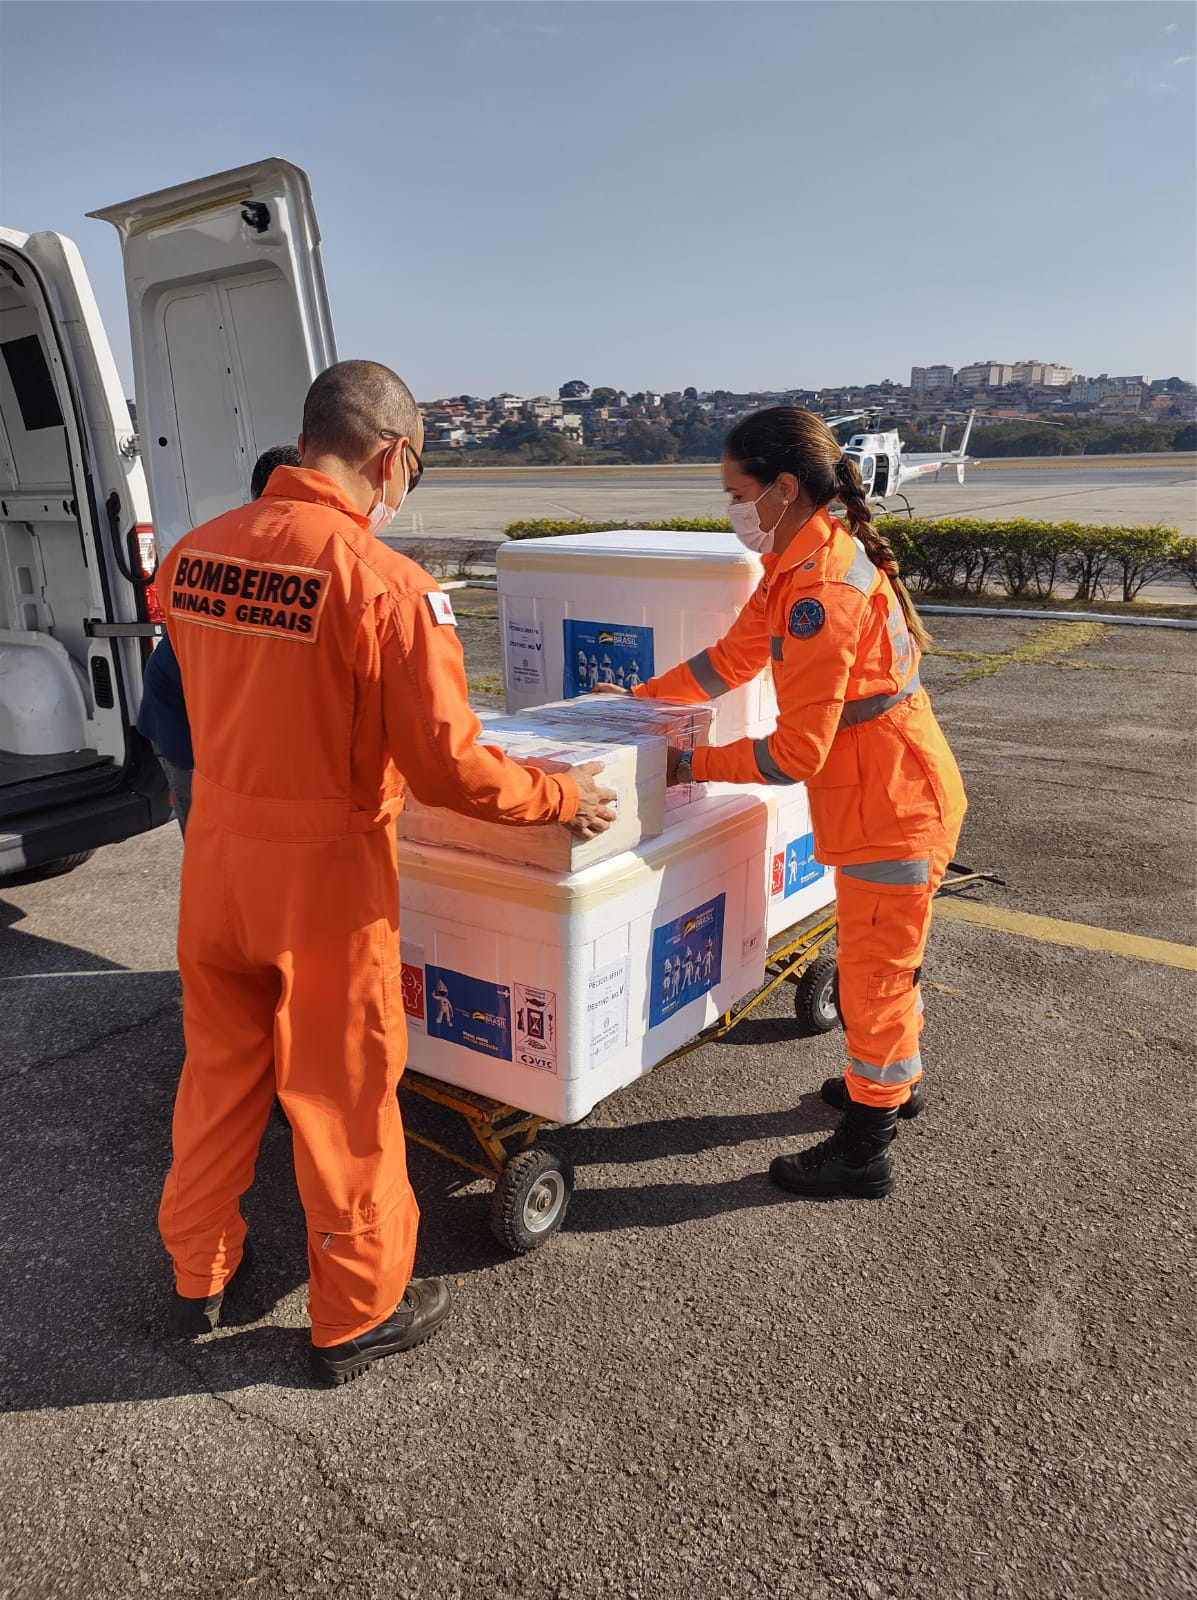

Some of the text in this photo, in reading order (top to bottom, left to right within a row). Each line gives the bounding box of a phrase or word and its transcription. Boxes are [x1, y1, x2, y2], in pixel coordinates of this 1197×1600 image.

[174, 557, 321, 609] BOMBEIROS
[172, 591, 312, 633] MINAS GERAIS
[613, 636, 639, 646] BRASIL
[695, 911, 714, 928] BRASIL
[485, 1015, 507, 1028] BRASIL
